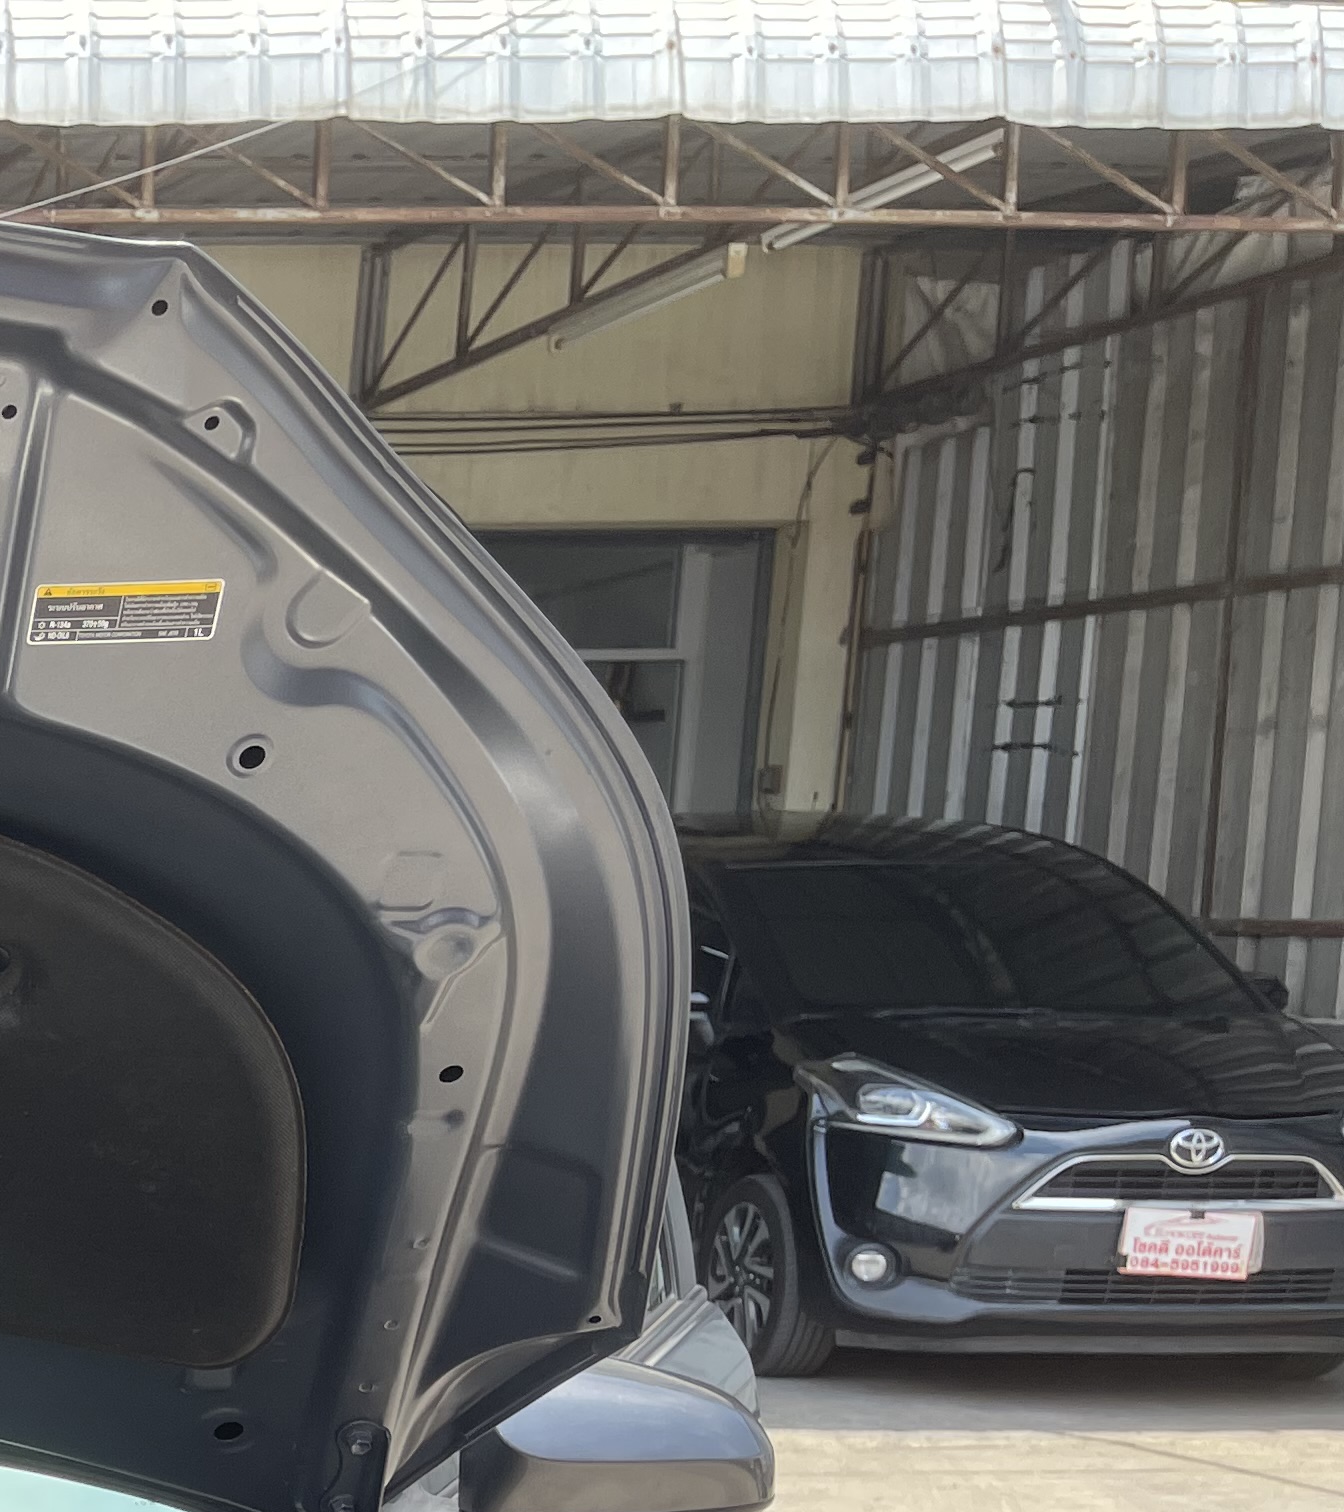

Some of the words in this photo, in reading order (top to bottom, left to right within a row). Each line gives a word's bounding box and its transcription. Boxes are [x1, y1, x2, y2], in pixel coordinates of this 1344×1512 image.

[48, 602, 104, 612] ระบบปรับอากาศ
[1132, 1236, 1170, 1255] โชคดี
